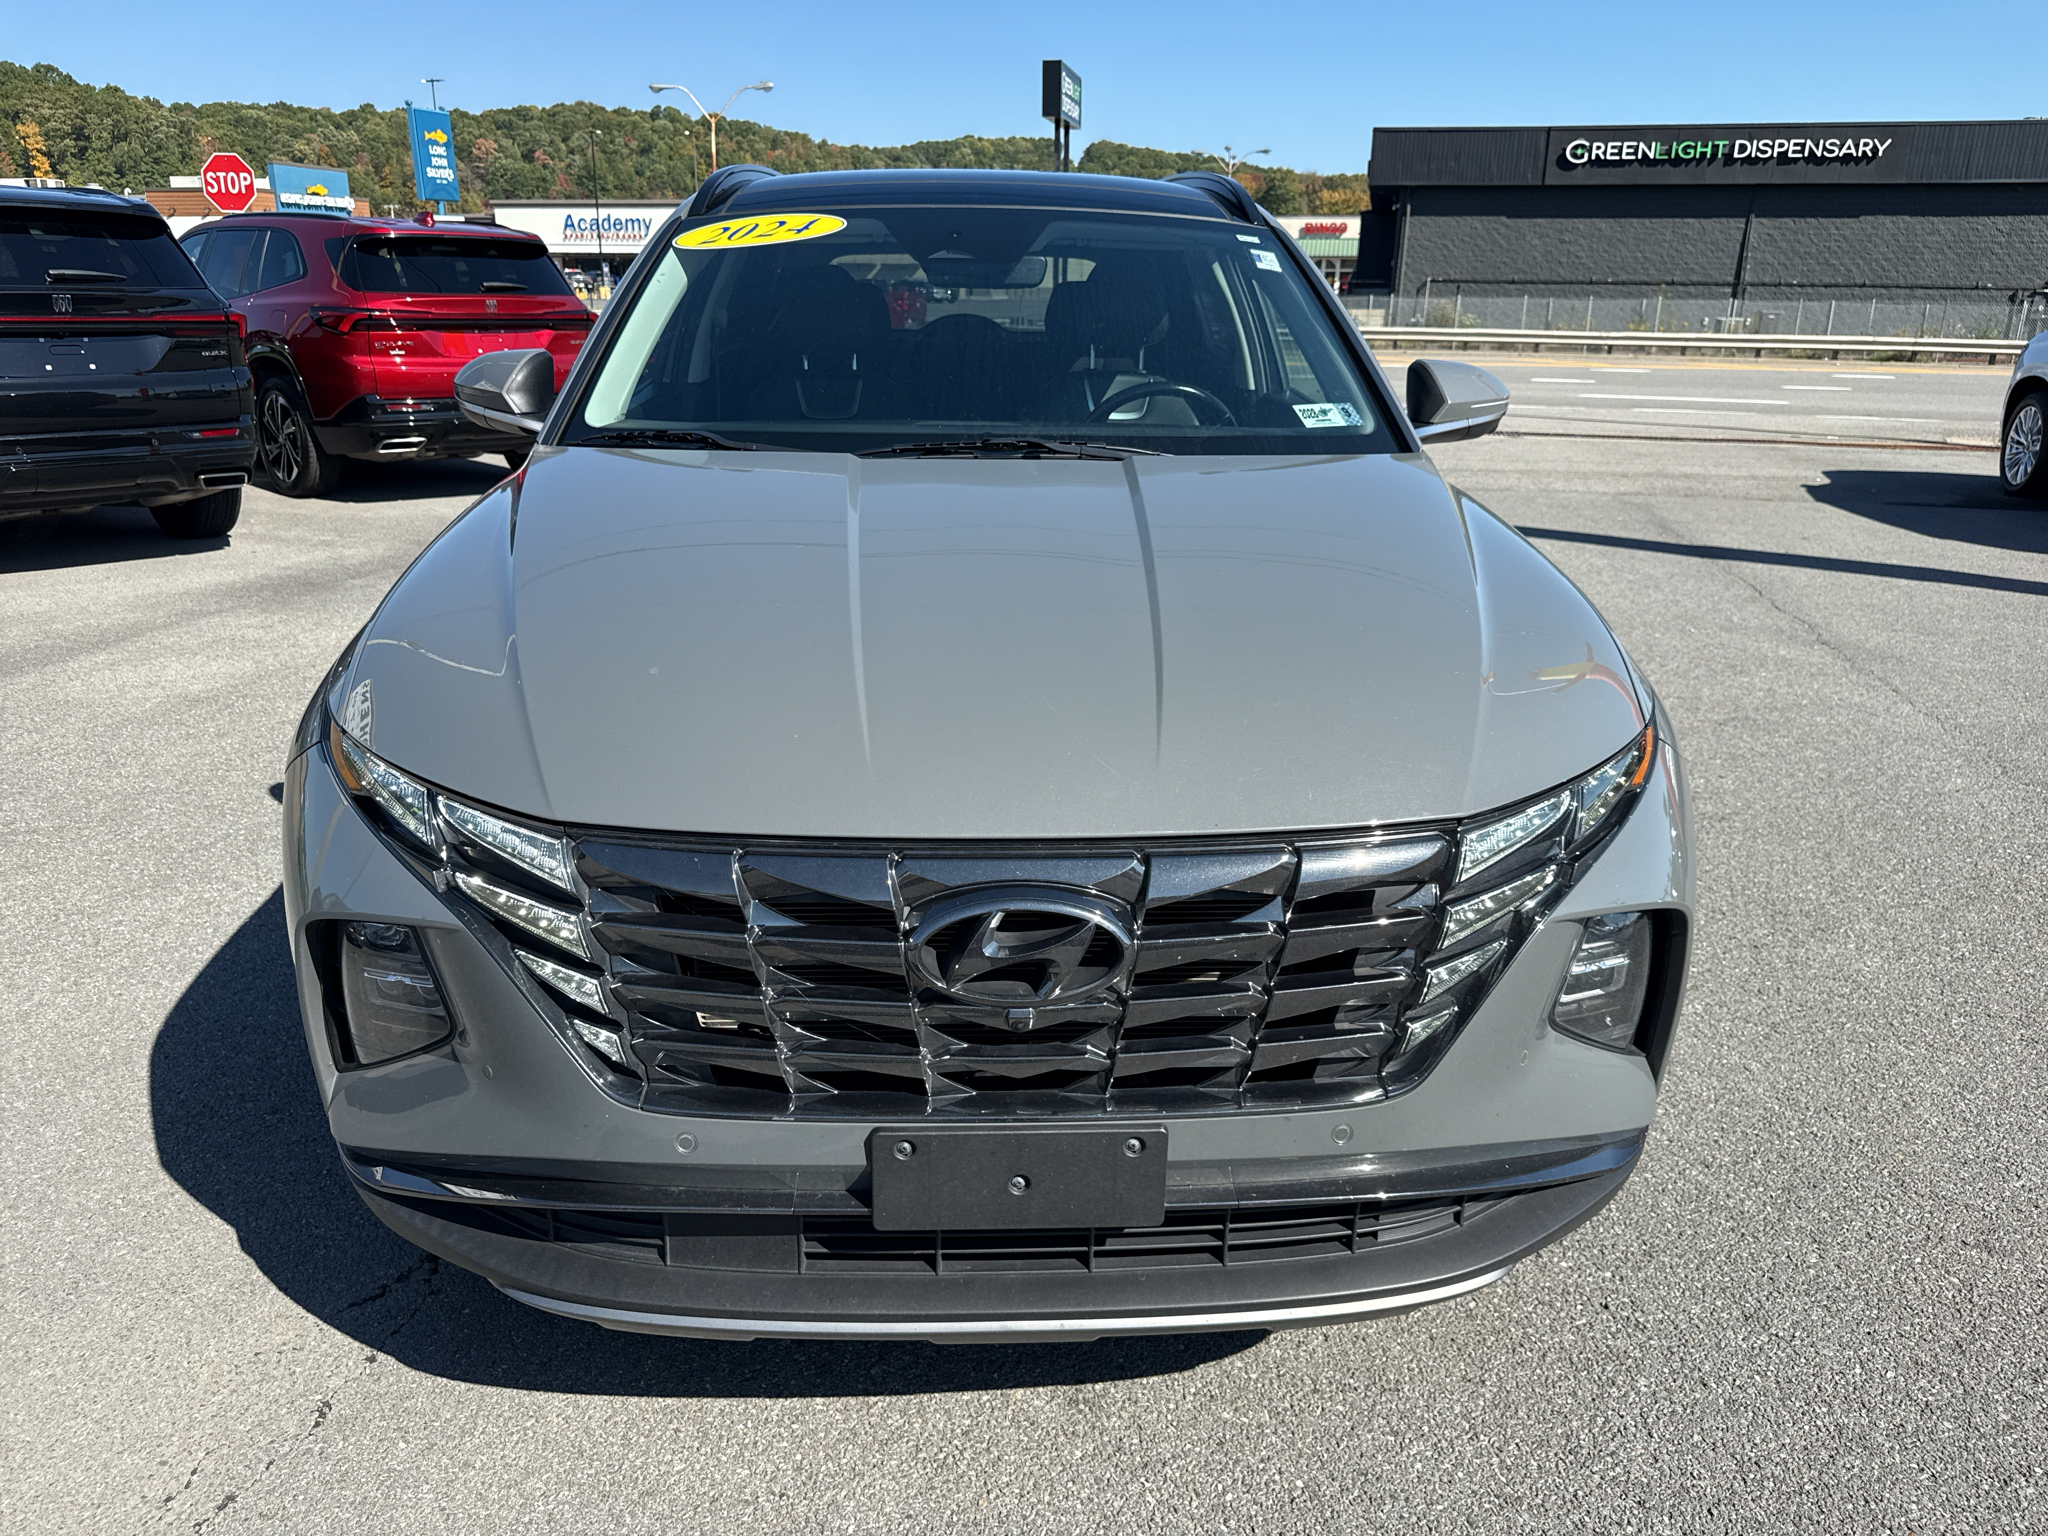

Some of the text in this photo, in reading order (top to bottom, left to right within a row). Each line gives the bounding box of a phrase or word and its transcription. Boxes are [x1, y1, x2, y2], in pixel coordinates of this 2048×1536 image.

[428, 144, 447, 156] LONG
[431, 156, 448, 167] JOHN
[1565, 138, 1892, 164] GREENLIGHT DISPENSARY
[205, 171, 251, 194] STOP
[563, 213, 652, 238] Academy
[695, 217, 821, 246] 2024
[1304, 222, 1348, 235] BINGO
